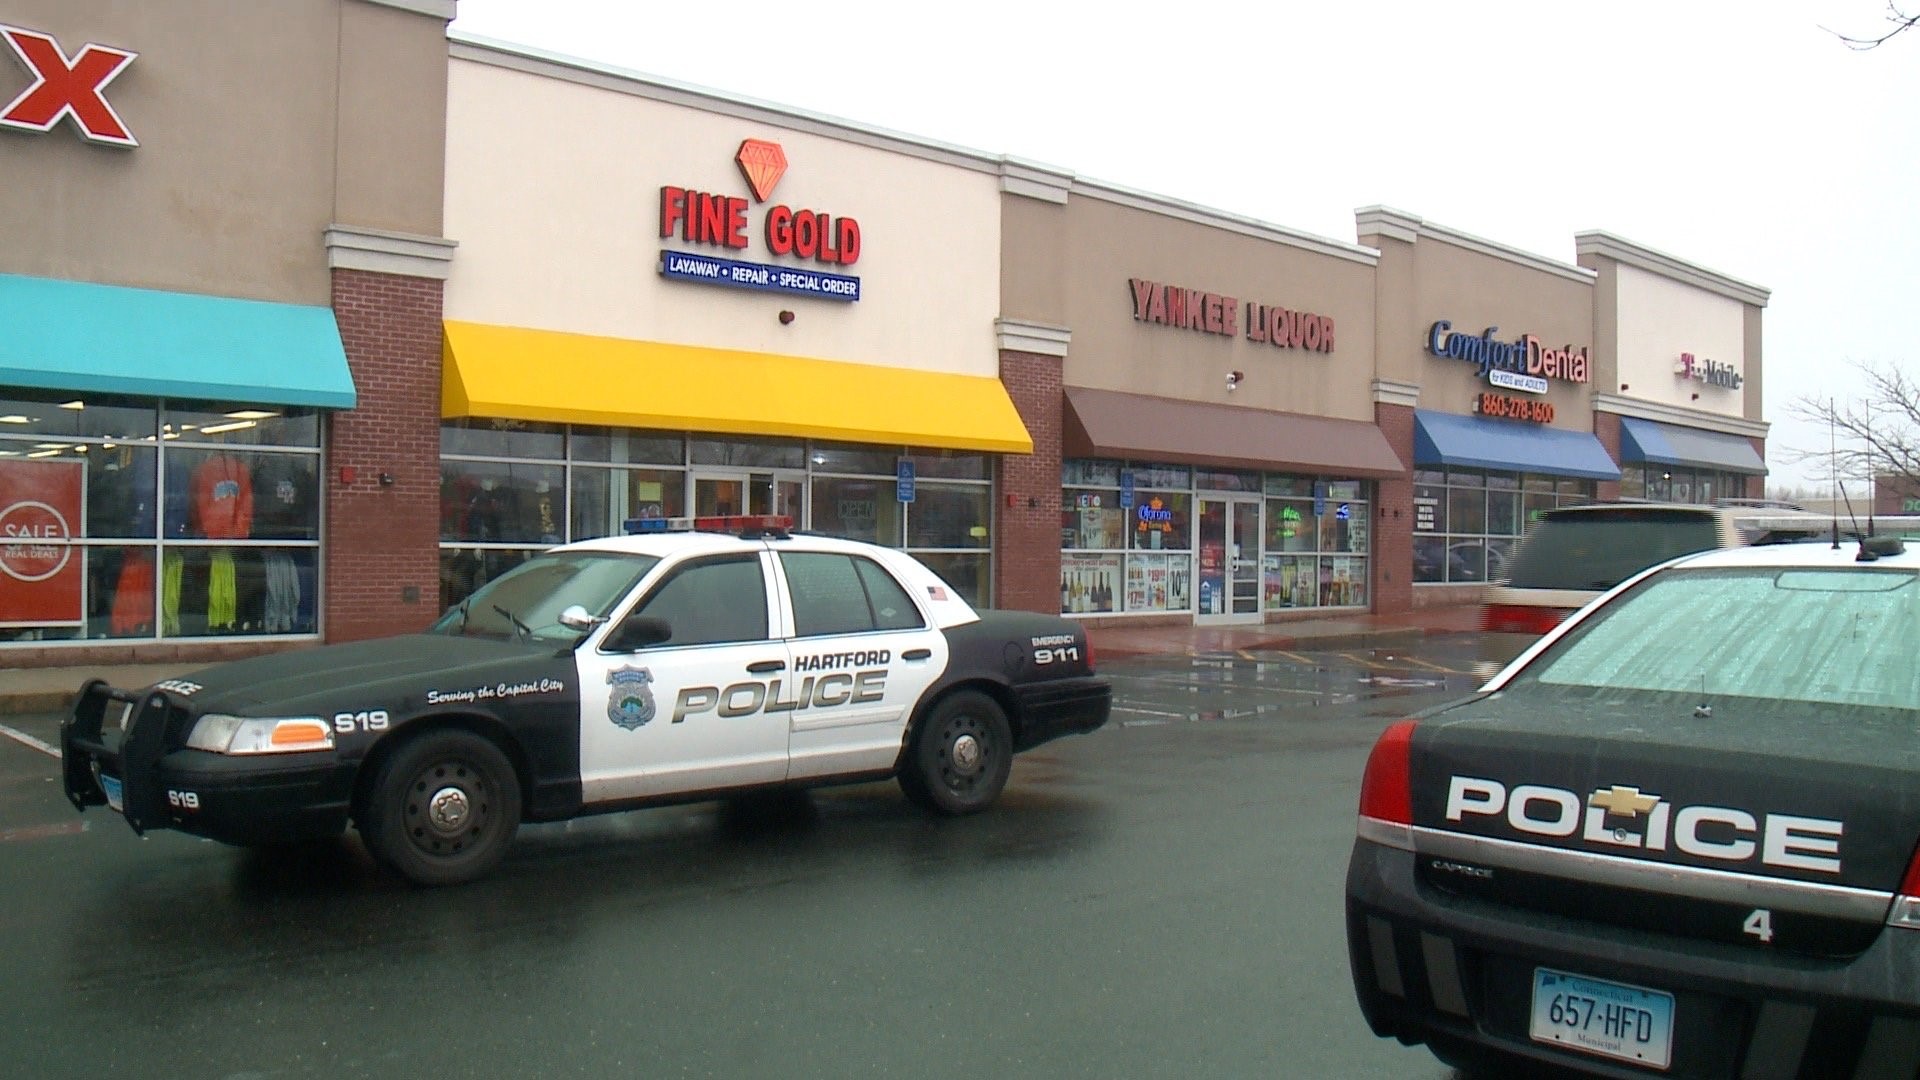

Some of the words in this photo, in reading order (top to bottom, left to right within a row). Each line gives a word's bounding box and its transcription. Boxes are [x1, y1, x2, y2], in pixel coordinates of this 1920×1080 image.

[0, 24, 139, 148] X
[660, 185, 748, 249] FINE
[765, 205, 861, 265] GOLD
[669, 257, 720, 278] LAYAWAY
[732, 267, 769, 286] REPAIR
[779, 272, 820, 291] SPECIAL
[822, 279, 857, 296] ORDER
[1128, 278, 1238, 338] YANKEE
[1246, 302, 1335, 353] LIQUOR
[1428, 320, 1526, 377] Comfort
[1525, 333, 1590, 384] Dental
[1500, 374, 1513, 385] KIDS
[1514, 378, 1524, 387] and
[1525, 379, 1546, 392] ADULTS
[5, 550, 28, 559] REAL
[1031, 635, 1075, 647] EMERGENCY
[795, 649, 891, 672] HARTFORD
[1034, 647, 1079, 665] 911
[427, 690, 475, 704] Serving
[478, 685, 495, 698] the
[496, 681, 539, 697] Capital
[540, 678, 563, 692] City
[671, 669, 888, 724] POLICE
[334, 710, 389, 732] S19
[168, 790, 199, 808] S19
[1445, 775, 1844, 873] POLICE
[1742, 909, 1774, 942] 4
[1571, 981, 1634, 1002] Connecticut
[1577, 1033, 1621, 1052] Municipal
